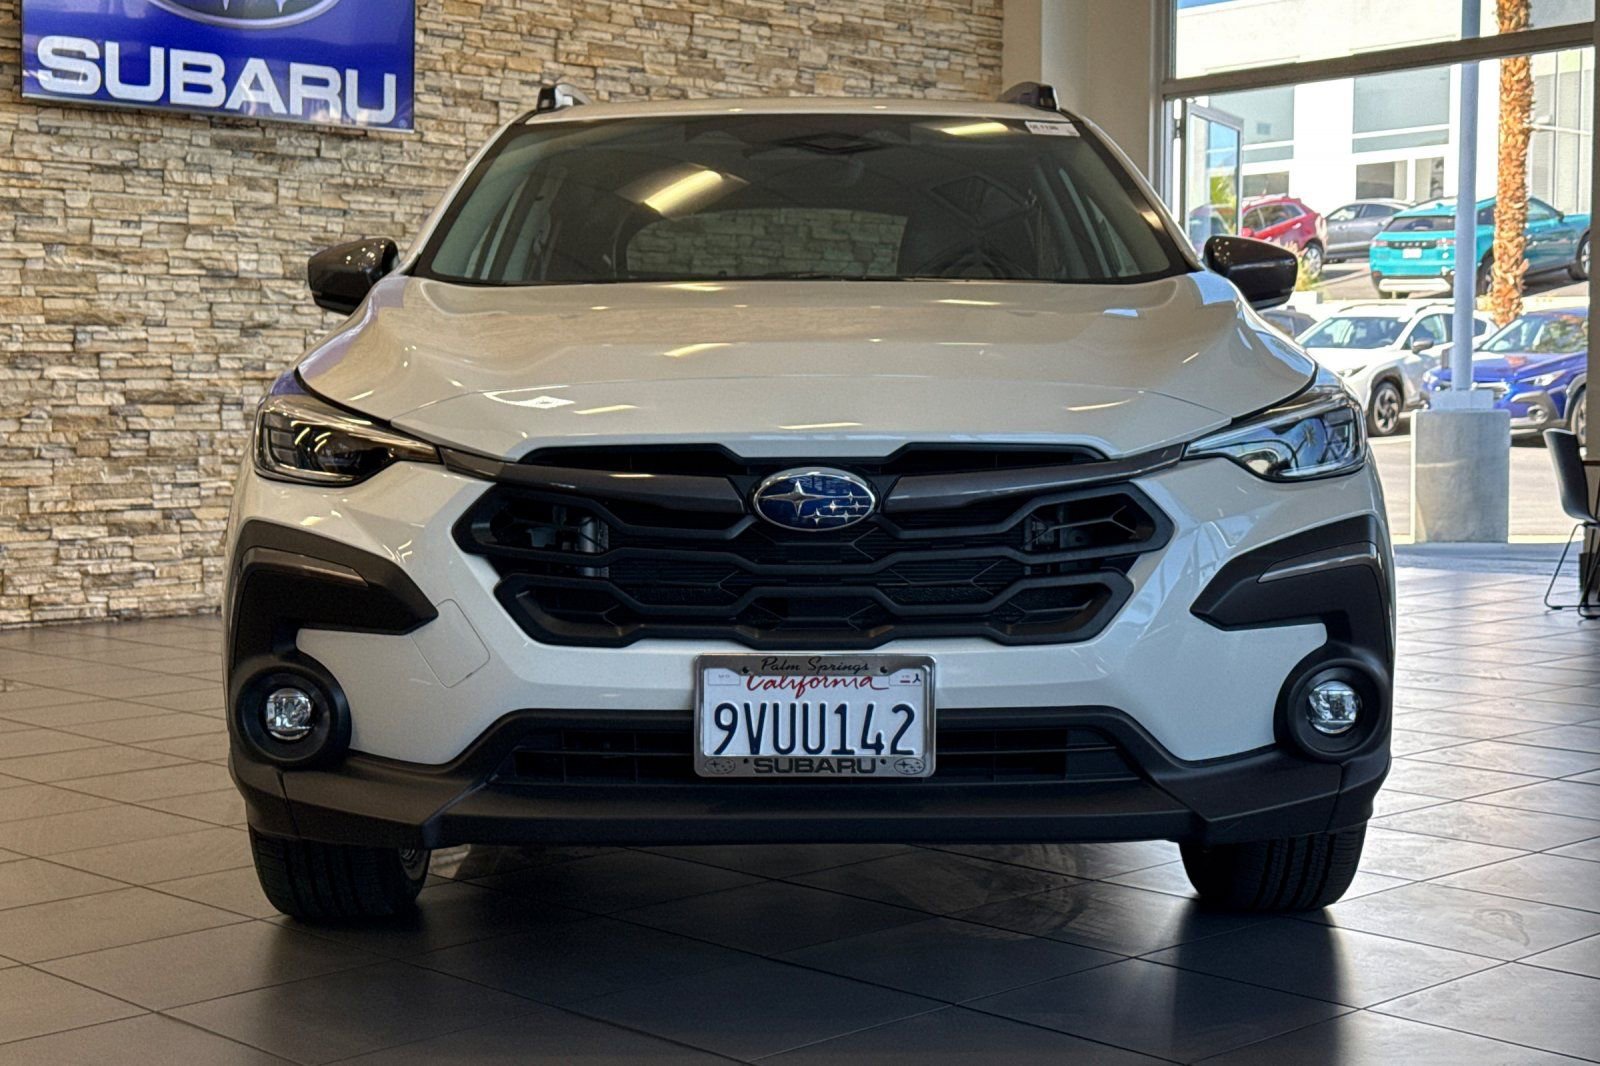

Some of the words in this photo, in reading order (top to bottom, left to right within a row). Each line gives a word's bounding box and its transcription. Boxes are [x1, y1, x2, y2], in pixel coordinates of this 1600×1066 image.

[36, 35, 397, 124] SUBARU
[761, 656, 800, 670] Palm
[807, 656, 869, 674] Springs
[746, 675, 889, 699] California
[713, 702, 915, 755] 9VUU142
[754, 757, 876, 773] SUBARU
